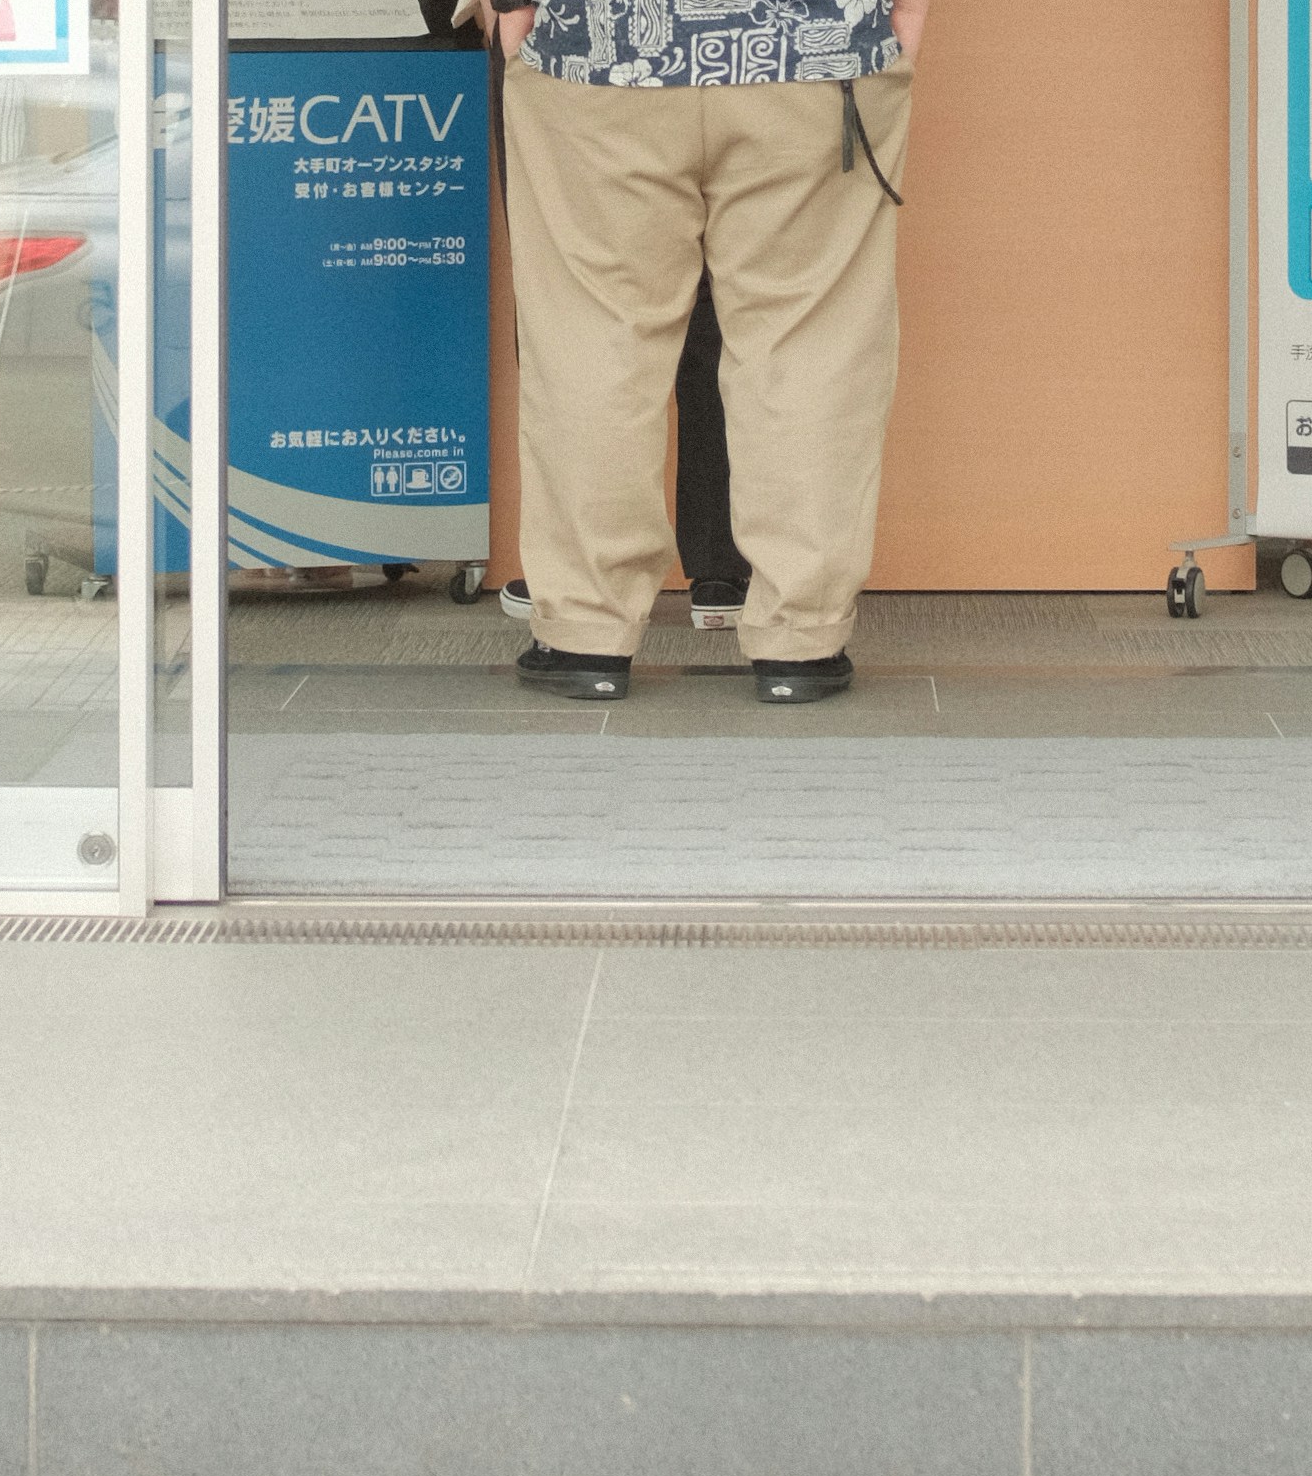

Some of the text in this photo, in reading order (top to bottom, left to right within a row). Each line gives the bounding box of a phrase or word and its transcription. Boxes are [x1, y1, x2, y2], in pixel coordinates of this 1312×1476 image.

[293, 155, 465, 174] 大手町オープンスタジオ
[294, 180, 465, 200] 受付・お客様センター
[270, 426, 466, 449] お気軽にお入りください。
